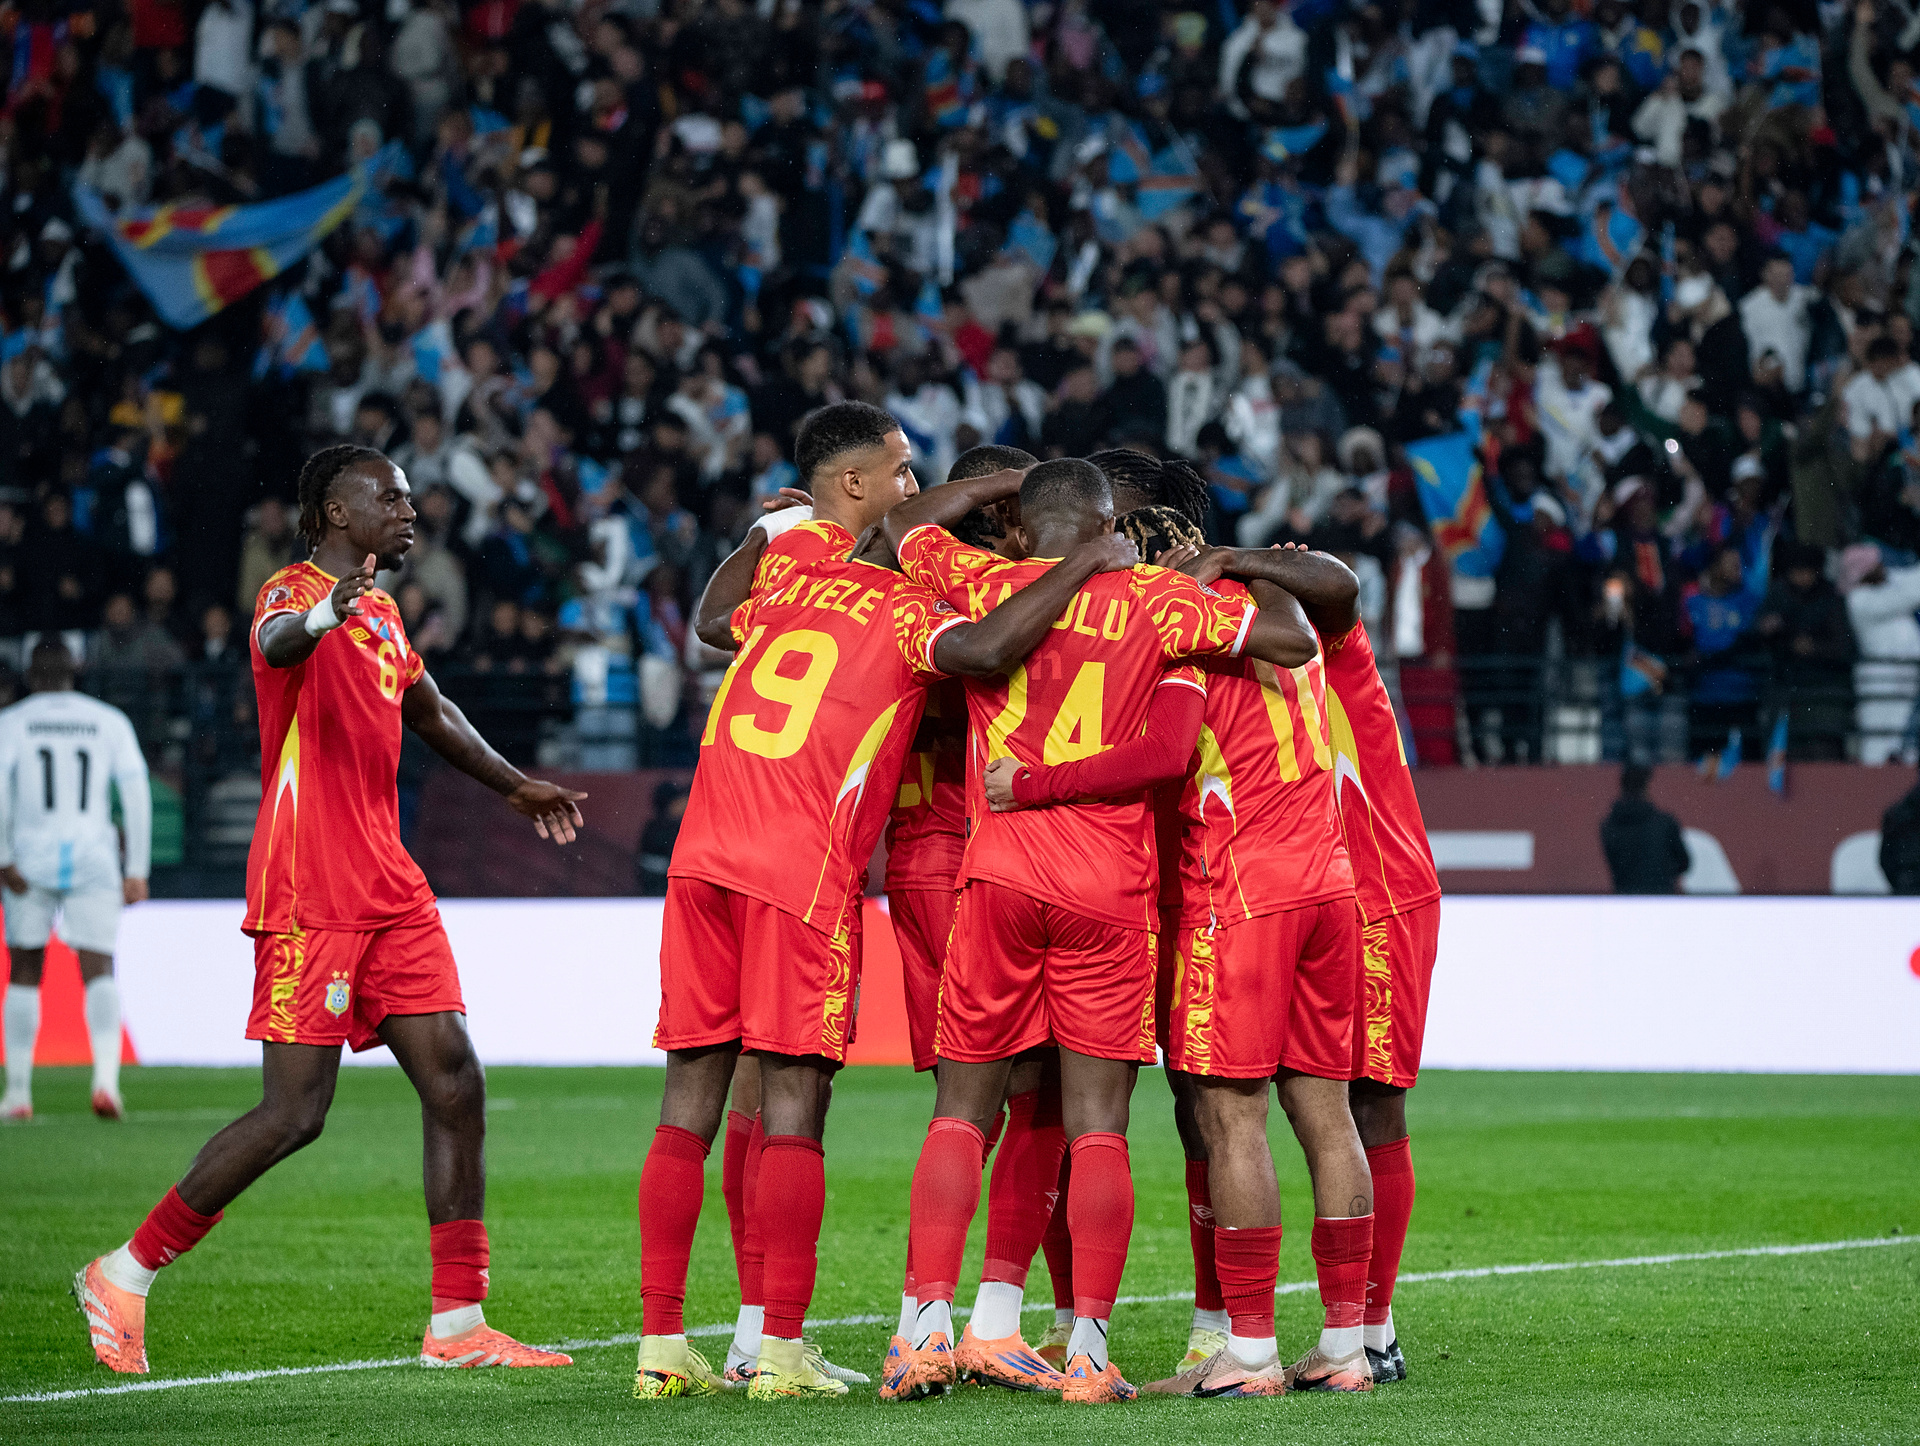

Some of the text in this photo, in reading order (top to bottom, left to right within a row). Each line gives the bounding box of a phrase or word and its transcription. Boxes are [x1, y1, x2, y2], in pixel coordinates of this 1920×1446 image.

[377, 641, 398, 700] 6
[701, 624, 839, 760] 19
[37, 747, 90, 813] 11
